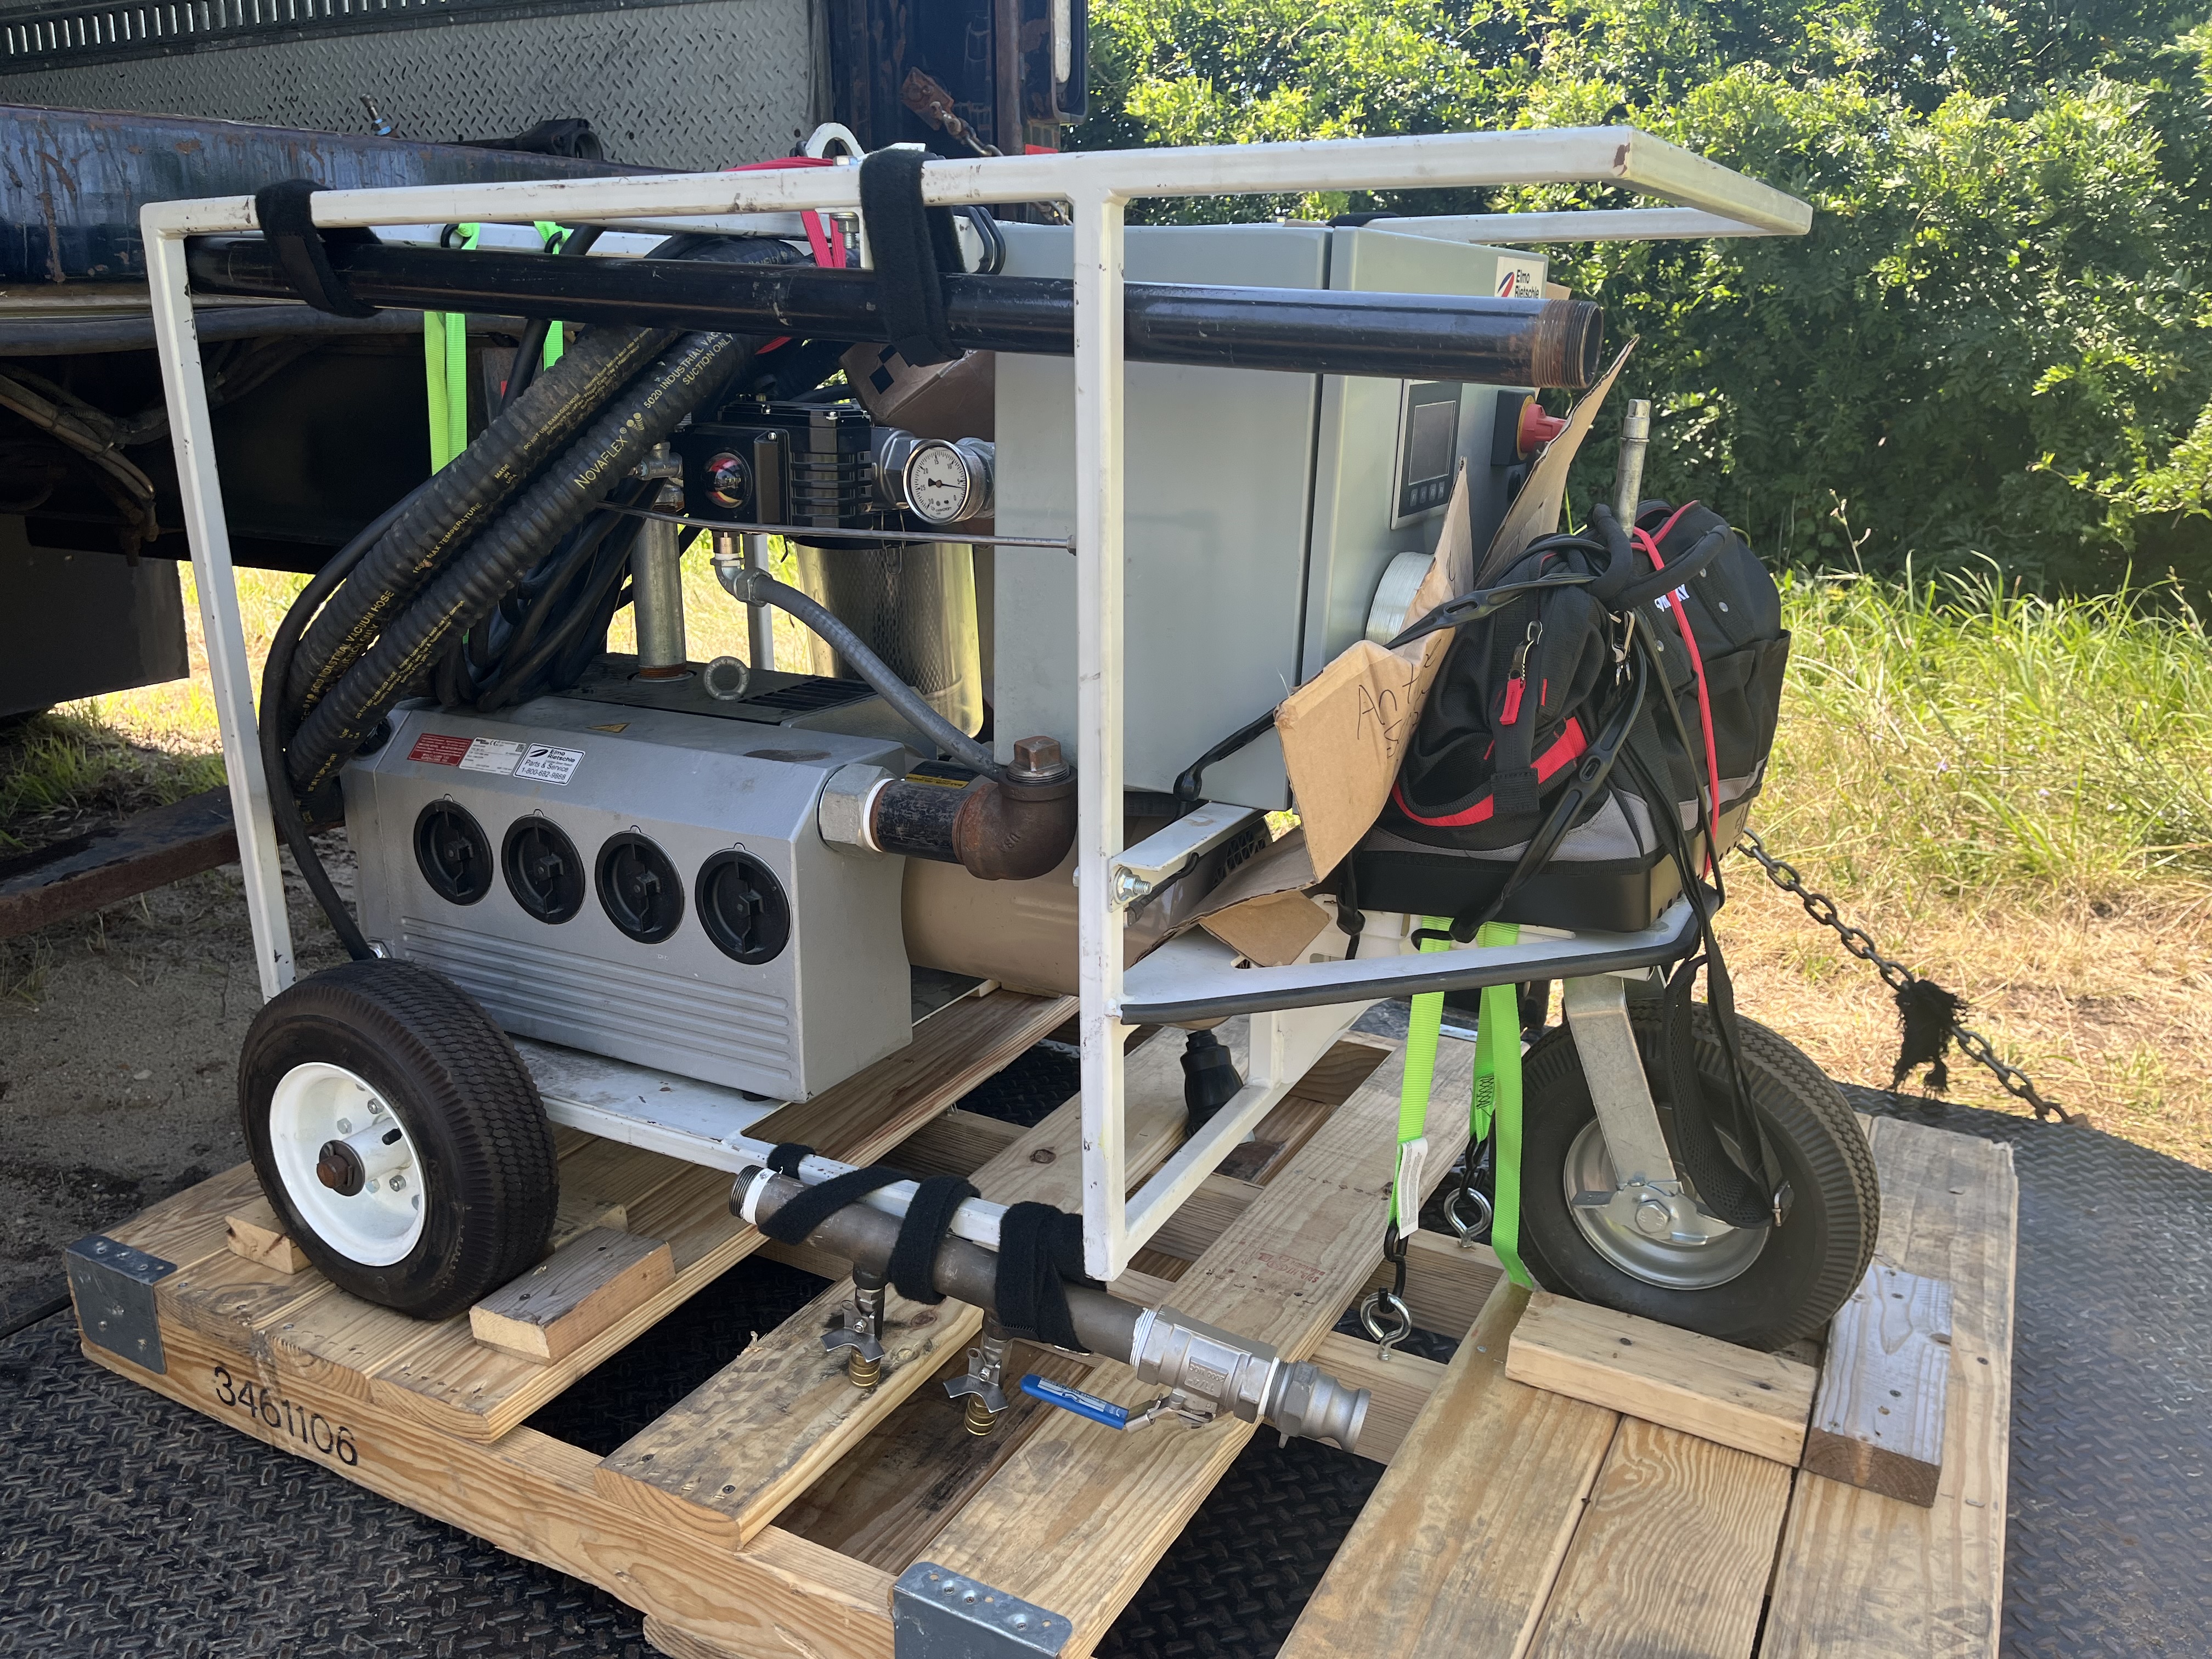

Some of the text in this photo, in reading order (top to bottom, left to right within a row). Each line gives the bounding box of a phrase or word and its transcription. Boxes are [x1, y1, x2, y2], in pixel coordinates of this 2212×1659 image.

[1515, 285, 1539, 298] Rietschle
[1516, 269, 1530, 284] Elmo
[642, 387, 664, 409] 5020
[658, 343, 706, 391] INDUSTRIAL
[680, 330, 735, 386] SUCTION ONLY
[522, 441, 532, 450] DO
[529, 432, 541, 444] NOT
[538, 423, 550, 435] USE
[546, 403, 571, 426] DAMAGED
[567, 392, 582, 405] HOSE
[493, 462, 511, 479] MADE
[502, 470, 511, 479] IN
[425, 544, 442, 560] MAX
[437, 500, 482, 548] TEMPERATURE
[345, 609, 375, 645] VACUUM
[370, 587, 394, 615] HOSE
[524, 759, 540, 768] Parts
[546, 763, 569, 772] Service
[215, 1365, 358, 1466] 3461106
